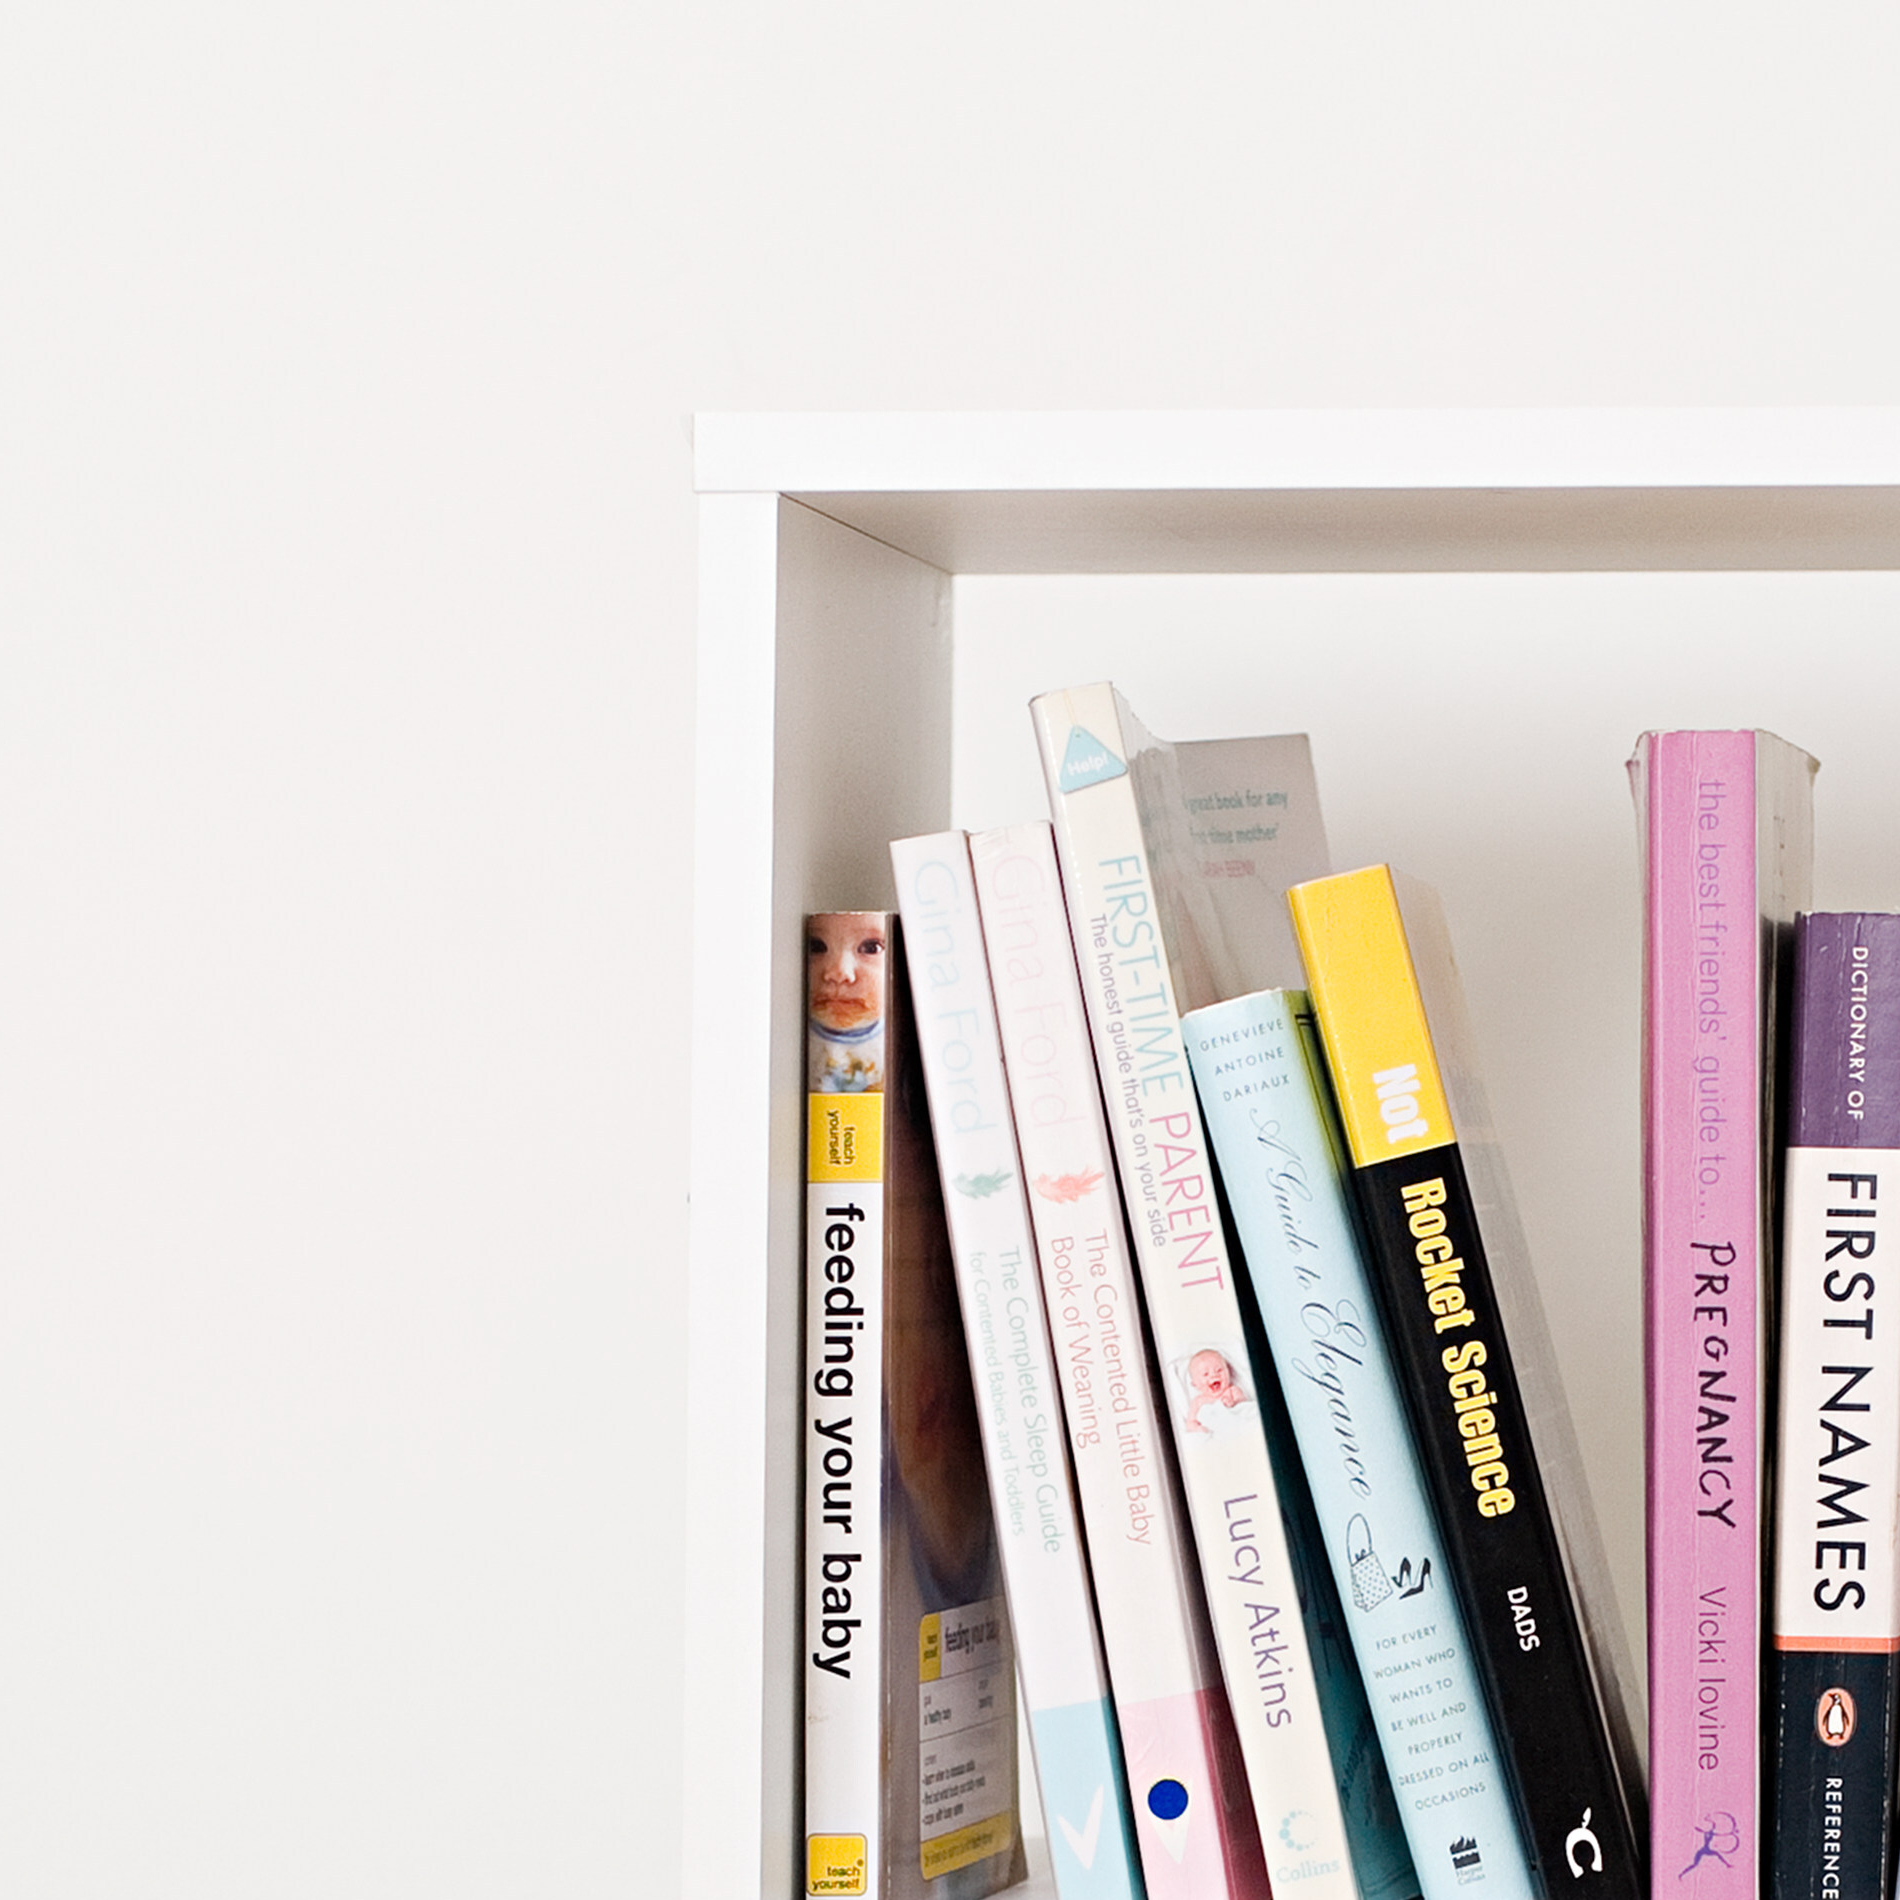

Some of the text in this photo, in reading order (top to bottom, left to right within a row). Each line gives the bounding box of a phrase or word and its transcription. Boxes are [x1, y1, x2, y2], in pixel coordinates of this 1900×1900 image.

[1066, 753, 1108, 776] Help!
[914, 860, 999, 1133] Gina Ford
[992, 854, 1088, 1129] Gina Ford
[1090, 913, 1167, 1248] The honest guide that's on your side
[1098, 855, 1224, 1290] FIRST-TIME PARENT
[1200, 1018, 1285, 1052] GENEVIEVE
[1214, 1046, 1286, 1077] ANTOINE
[1222, 1073, 1291, 1102] DARIAUX
[1691, 778, 1729, 1221] the best friends' guide to...
[1846, 946, 1870, 1122] DICTIONARY OF
[1000, 1246, 1067, 1553] The Complete Sleep Guide
[1051, 1236, 1102, 1450] Book of Weaning
[1085, 1228, 1156, 1546] The Contented Little Baby
[1372, 1063, 1517, 1518] Not Rocket Science
[1690, 1241, 1738, 1530] PREGNANCY
[1813, 1173, 1879, 1611] FIRST NAMES
[812, 1202, 865, 1680] feeding your baby
[1223, 1494, 1295, 1729] Lucy Atkins
[1506, 1585, 1541, 1652] DADS
[1398, 1751, 1491, 1787] DRESSED ON ALL
[1822, 1777, 1844, 1900] REFERENCE
